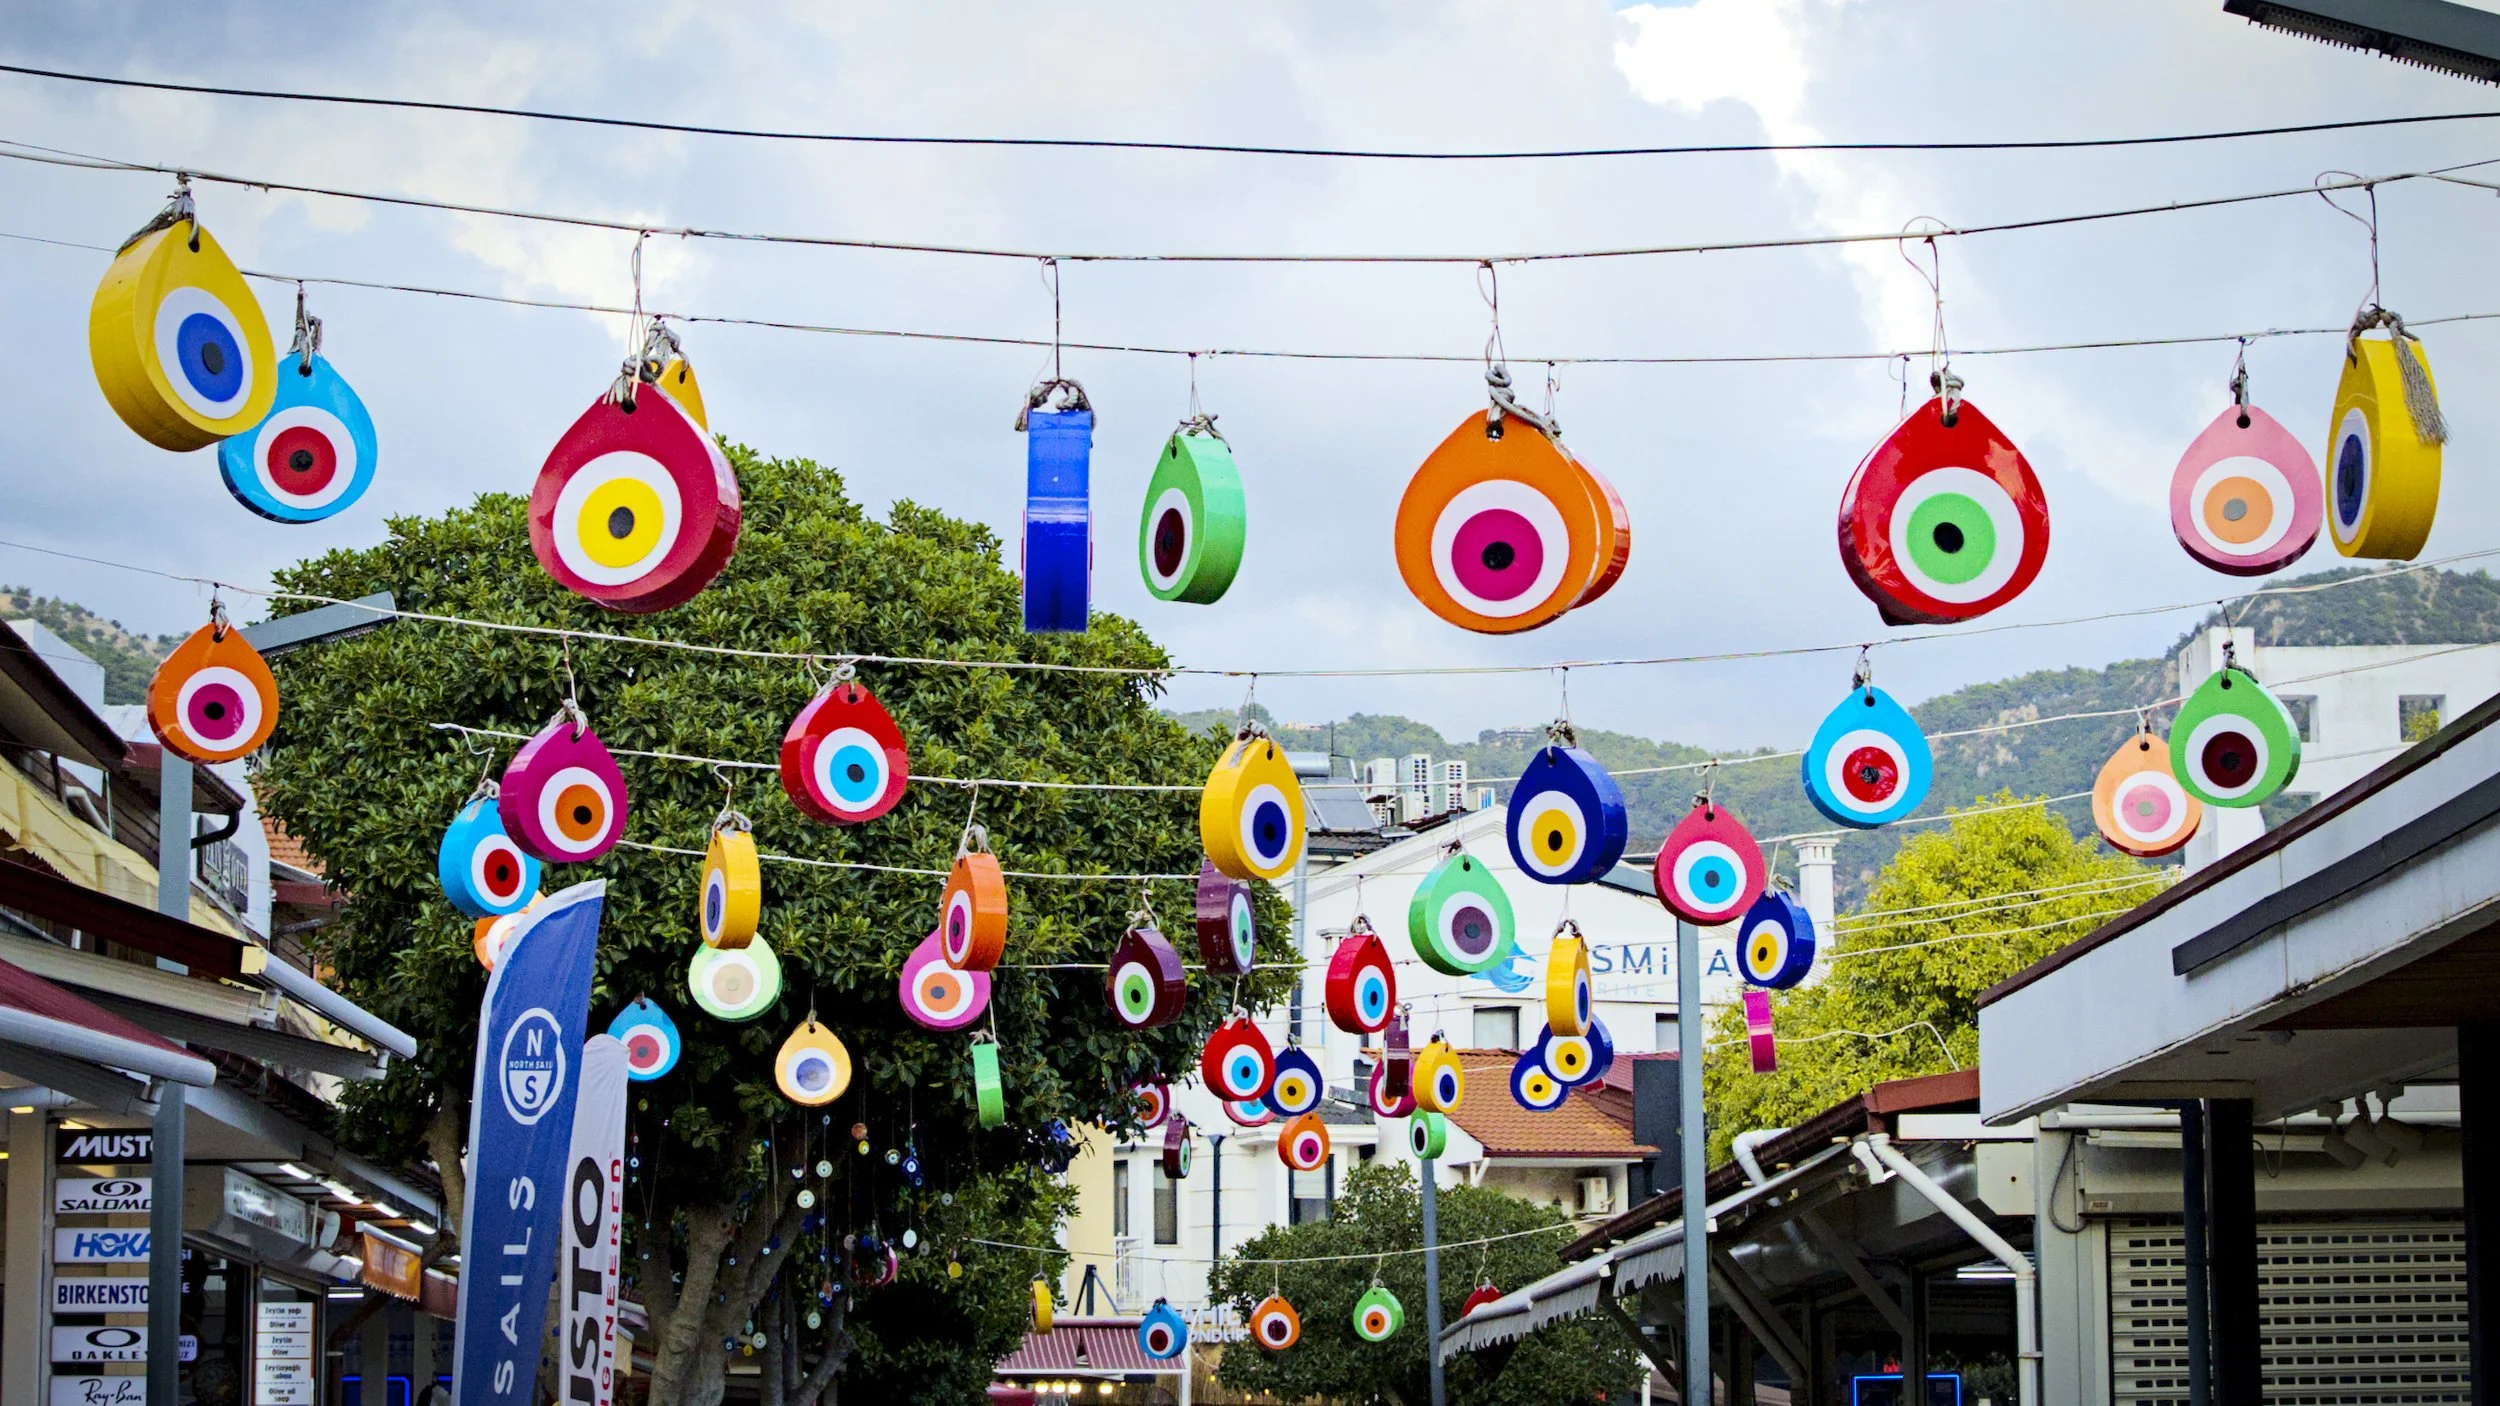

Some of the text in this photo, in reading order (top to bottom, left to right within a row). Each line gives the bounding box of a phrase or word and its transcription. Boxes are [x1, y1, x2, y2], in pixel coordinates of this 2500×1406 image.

[526, 1028, 543, 1057] N
[508, 1060, 534, 1070] NORTH
[524, 1075, 537, 1105] S
[63, 1135, 153, 1158] MUST
[60, 1199, 152, 1211] SALOMO
[494, 1175, 536, 1395] SAILS
[570, 1156, 605, 1406] USTO
[600, 1159, 622, 1406] GINEERED
[57, 1285, 149, 1305] BIRKENSTO
[72, 1351, 148, 1360] OAKLE
[79, 1379, 143, 1406] Ray-Ban
